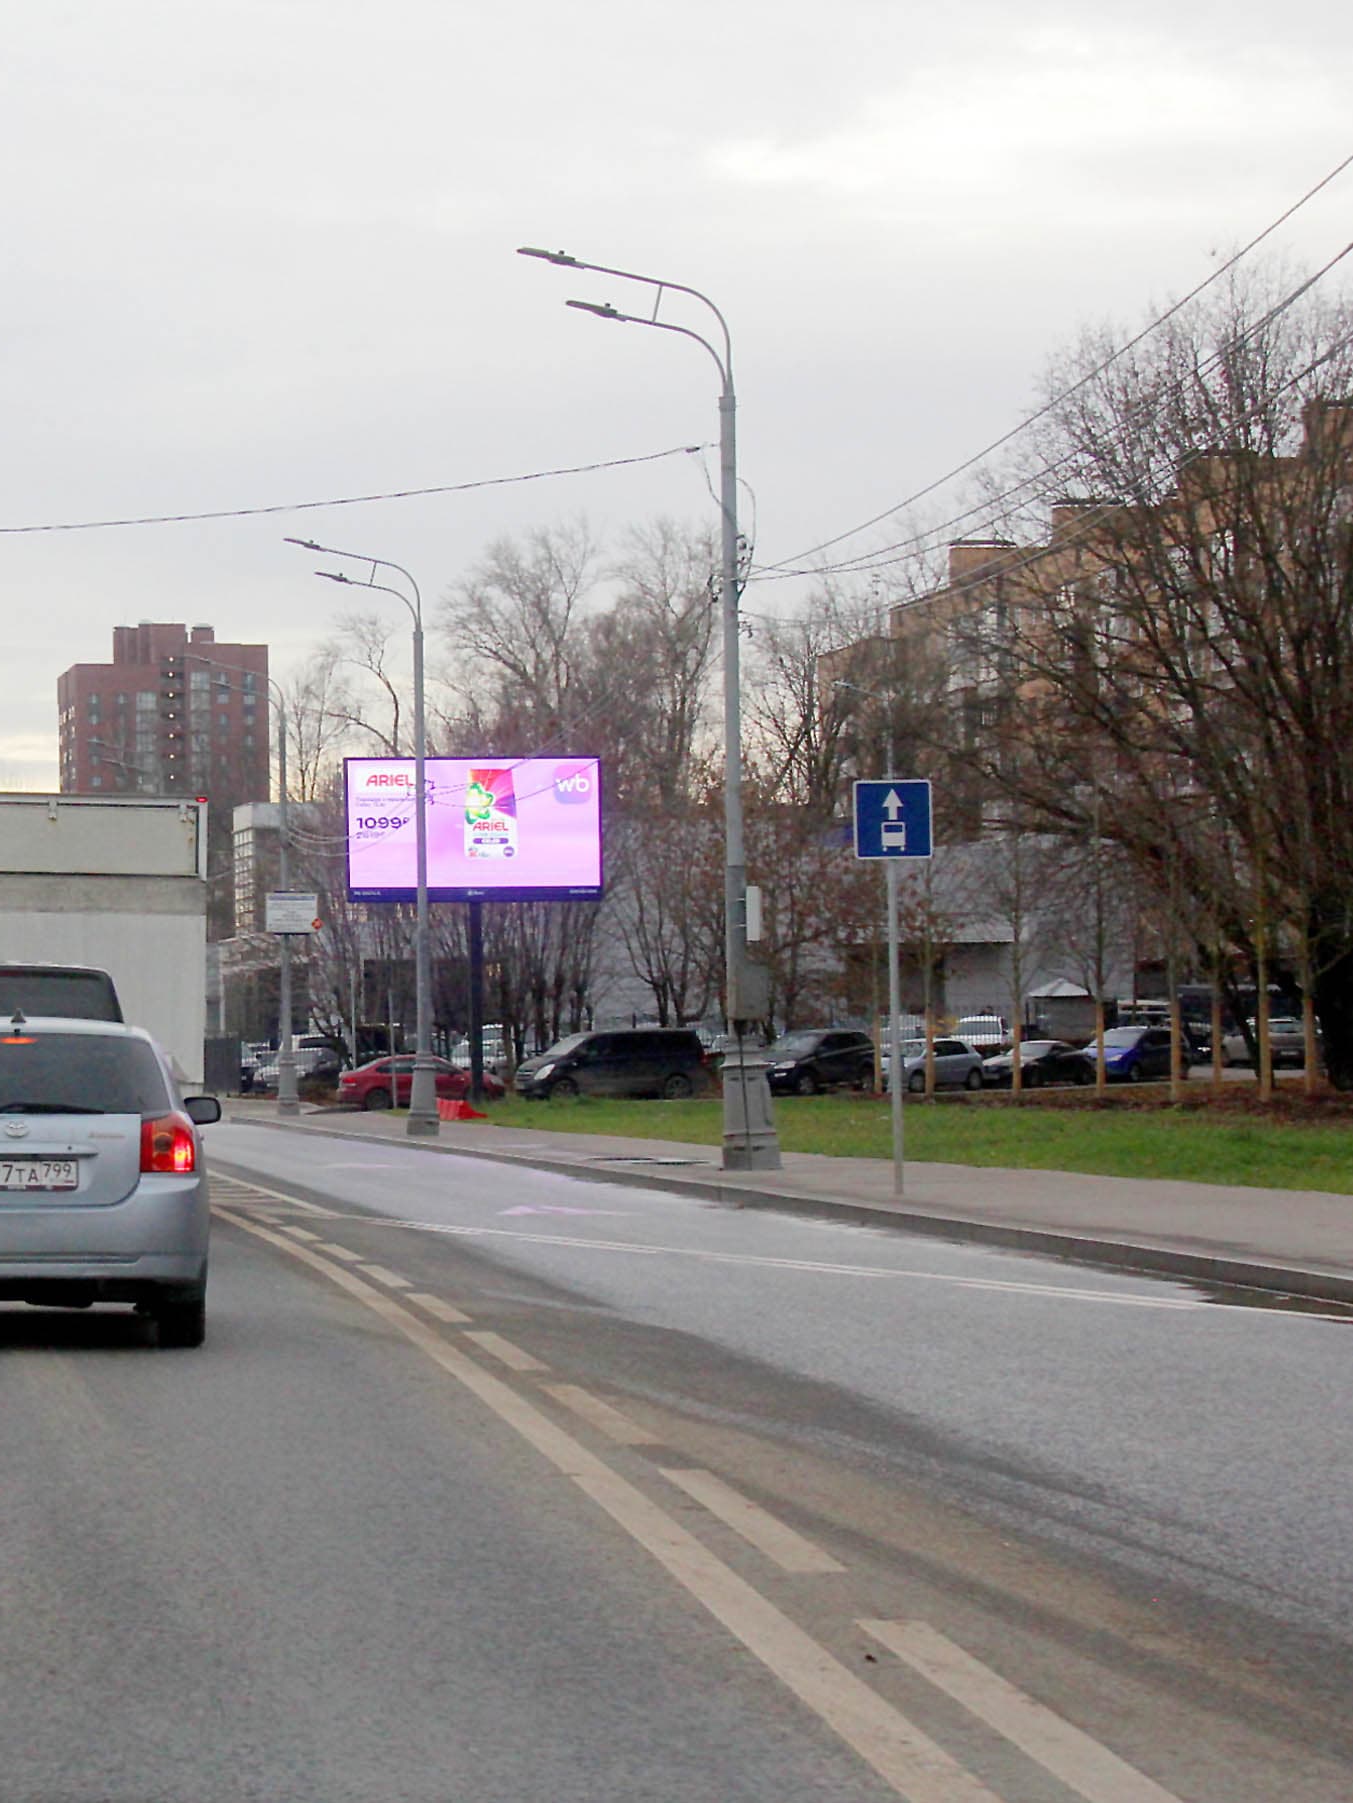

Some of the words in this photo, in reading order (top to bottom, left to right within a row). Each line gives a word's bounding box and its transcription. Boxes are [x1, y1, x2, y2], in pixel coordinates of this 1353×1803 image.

[365, 774, 415, 787] ARIEL
[555, 773, 590, 793] wb
[472, 821, 509, 832] ARIEL
